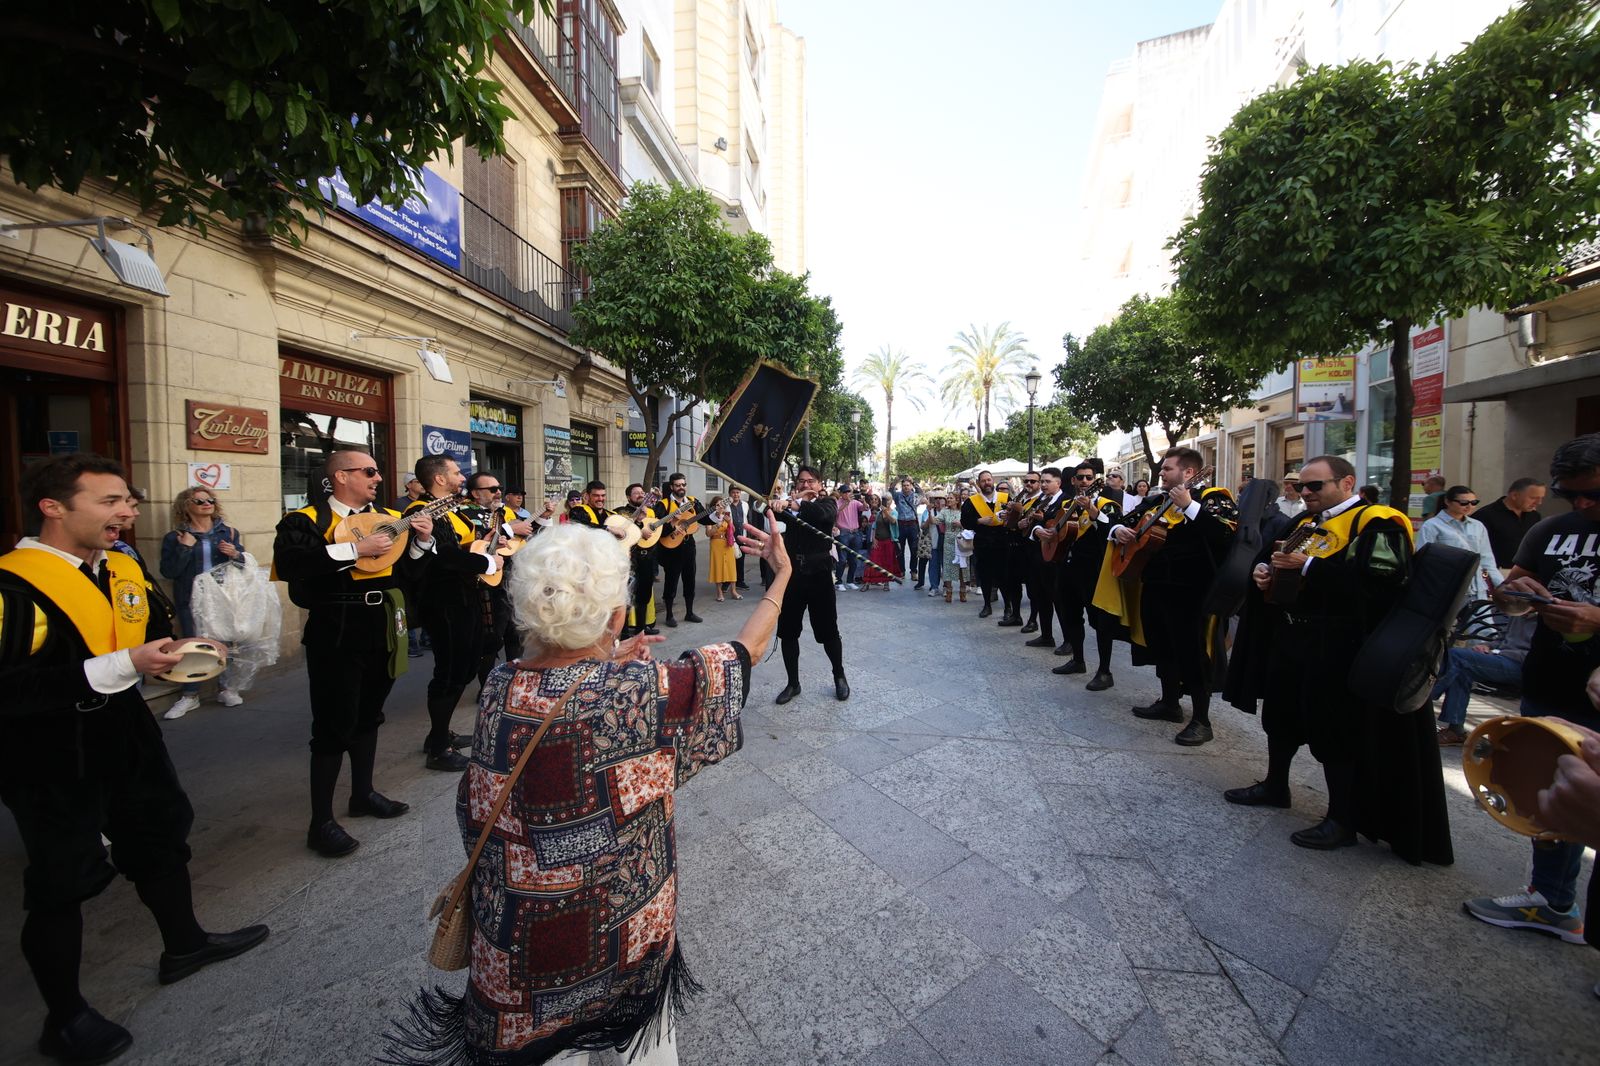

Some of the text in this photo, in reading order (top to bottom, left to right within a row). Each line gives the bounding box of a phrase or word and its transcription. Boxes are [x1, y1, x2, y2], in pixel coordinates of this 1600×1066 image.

[366, 205, 413, 235] Comunicación
[418, 233, 435, 248] Redes
[435, 243, 457, 260] Sociales
[402, 212, 419, 228] Fiscal
[423, 226, 447, 245] Contable
[1, 303, 106, 352] ERIA
[279, 359, 382, 396] LIMPIEZA
[301, 384, 364, 406] EN SECO
[1544, 533, 1580, 556] LA
